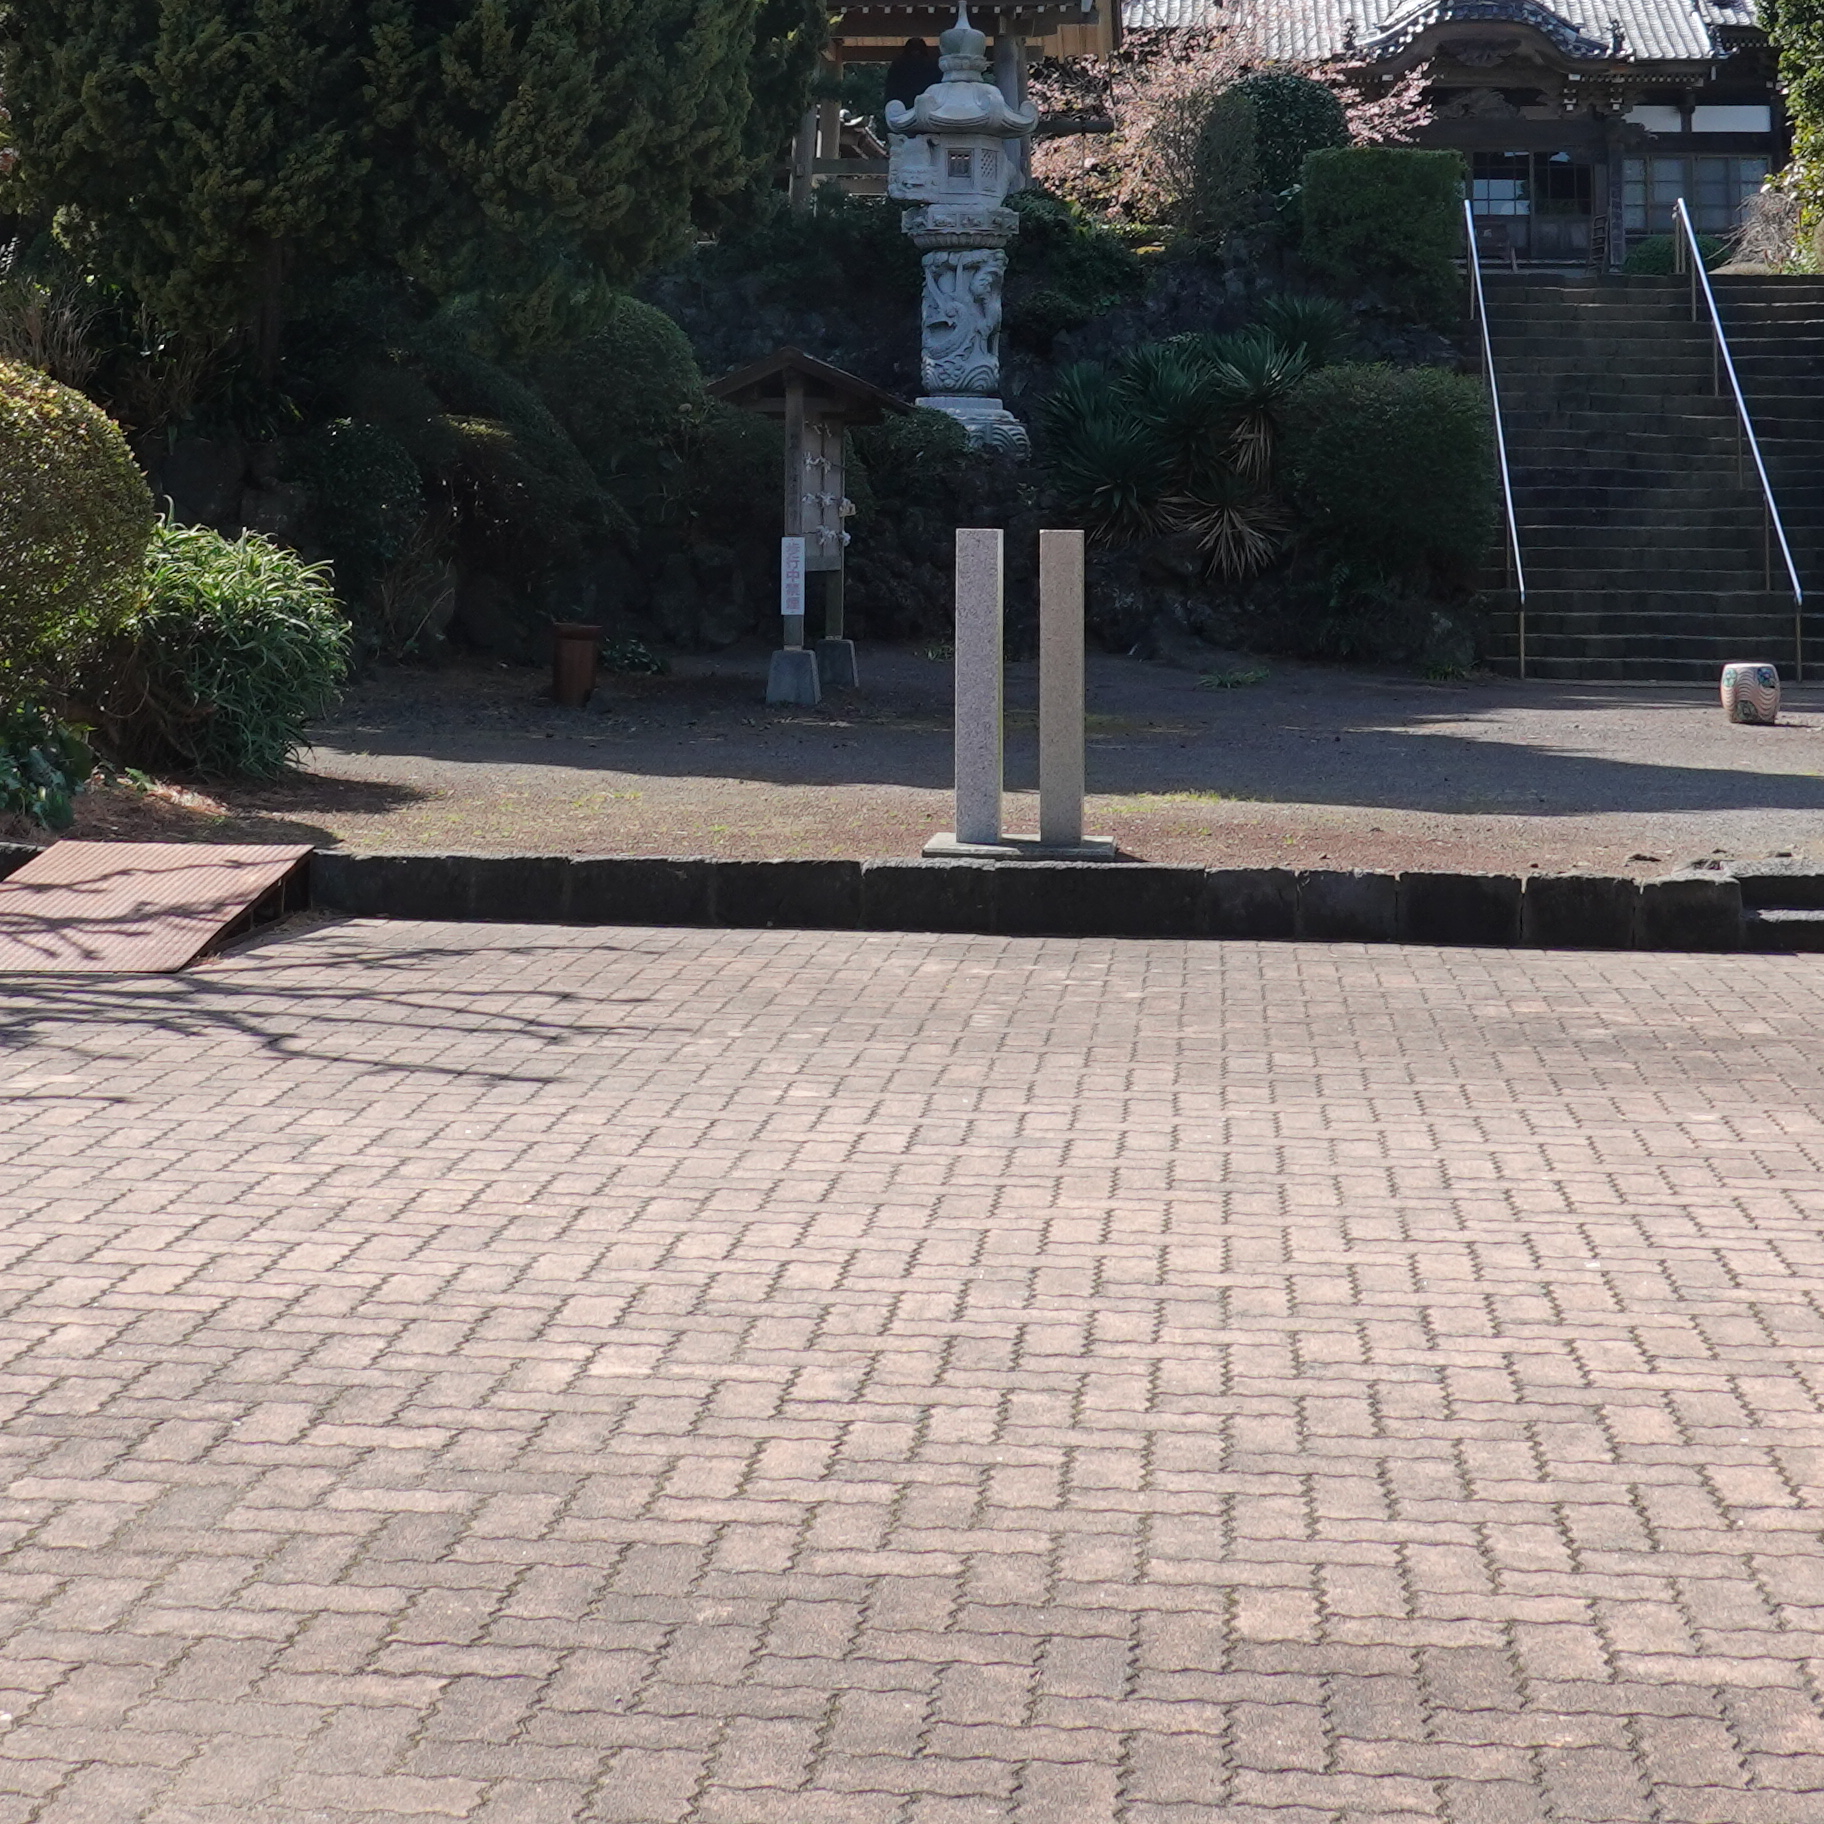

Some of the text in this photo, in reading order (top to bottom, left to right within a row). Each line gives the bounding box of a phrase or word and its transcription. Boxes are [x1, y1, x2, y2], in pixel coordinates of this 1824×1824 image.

[786, 543, 801, 609] 歩行中禁煙
